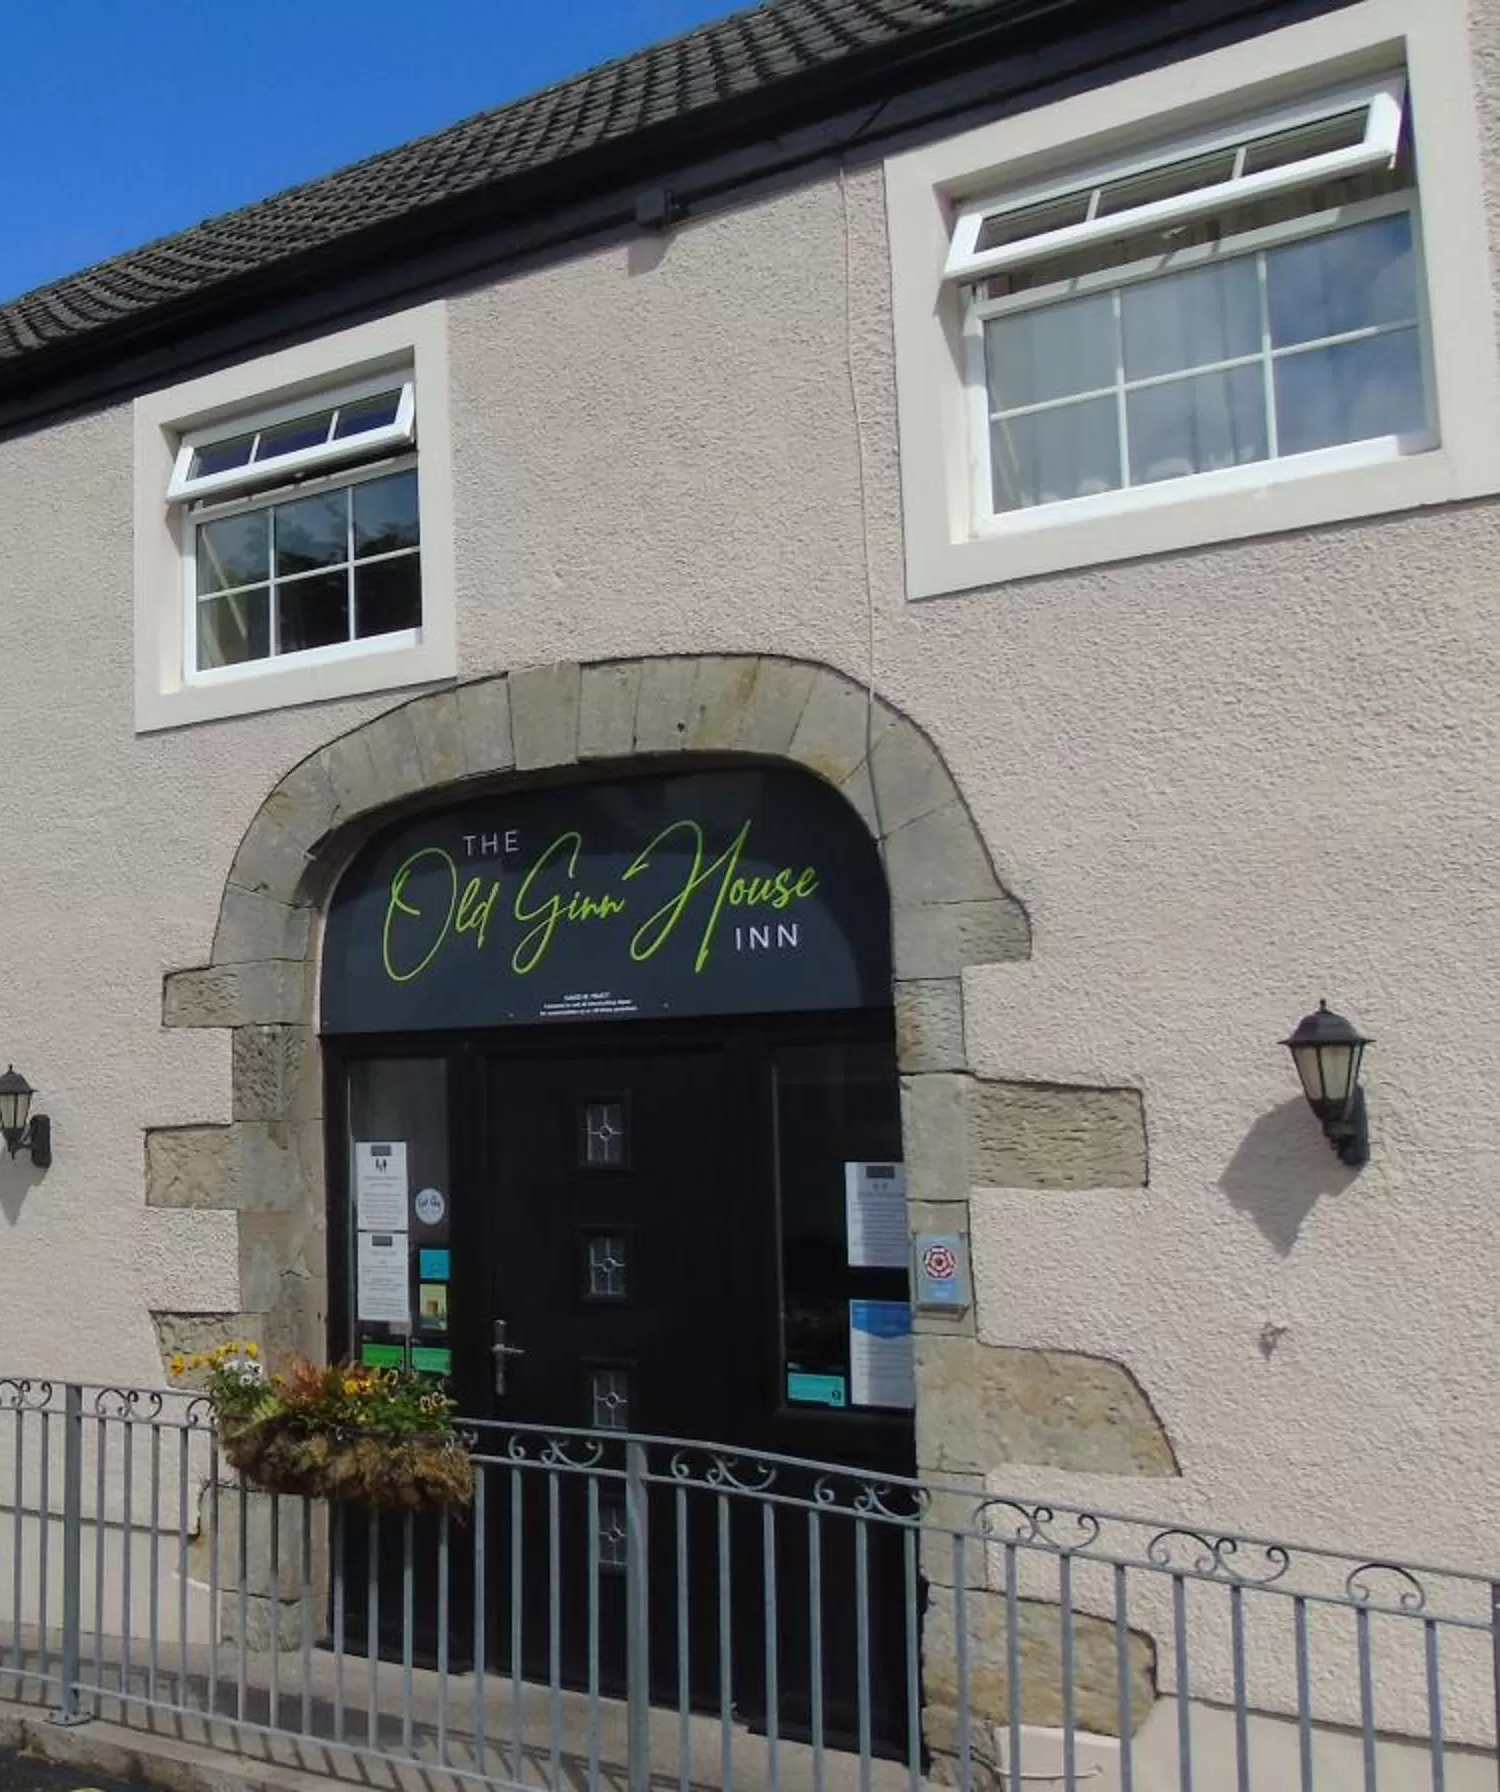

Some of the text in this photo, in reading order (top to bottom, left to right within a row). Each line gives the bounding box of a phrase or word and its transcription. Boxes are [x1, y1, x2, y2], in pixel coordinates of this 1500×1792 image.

[463, 830, 520, 856] THE
[383, 819, 821, 981] Old Ginn House
[735, 923, 799, 951] INN
